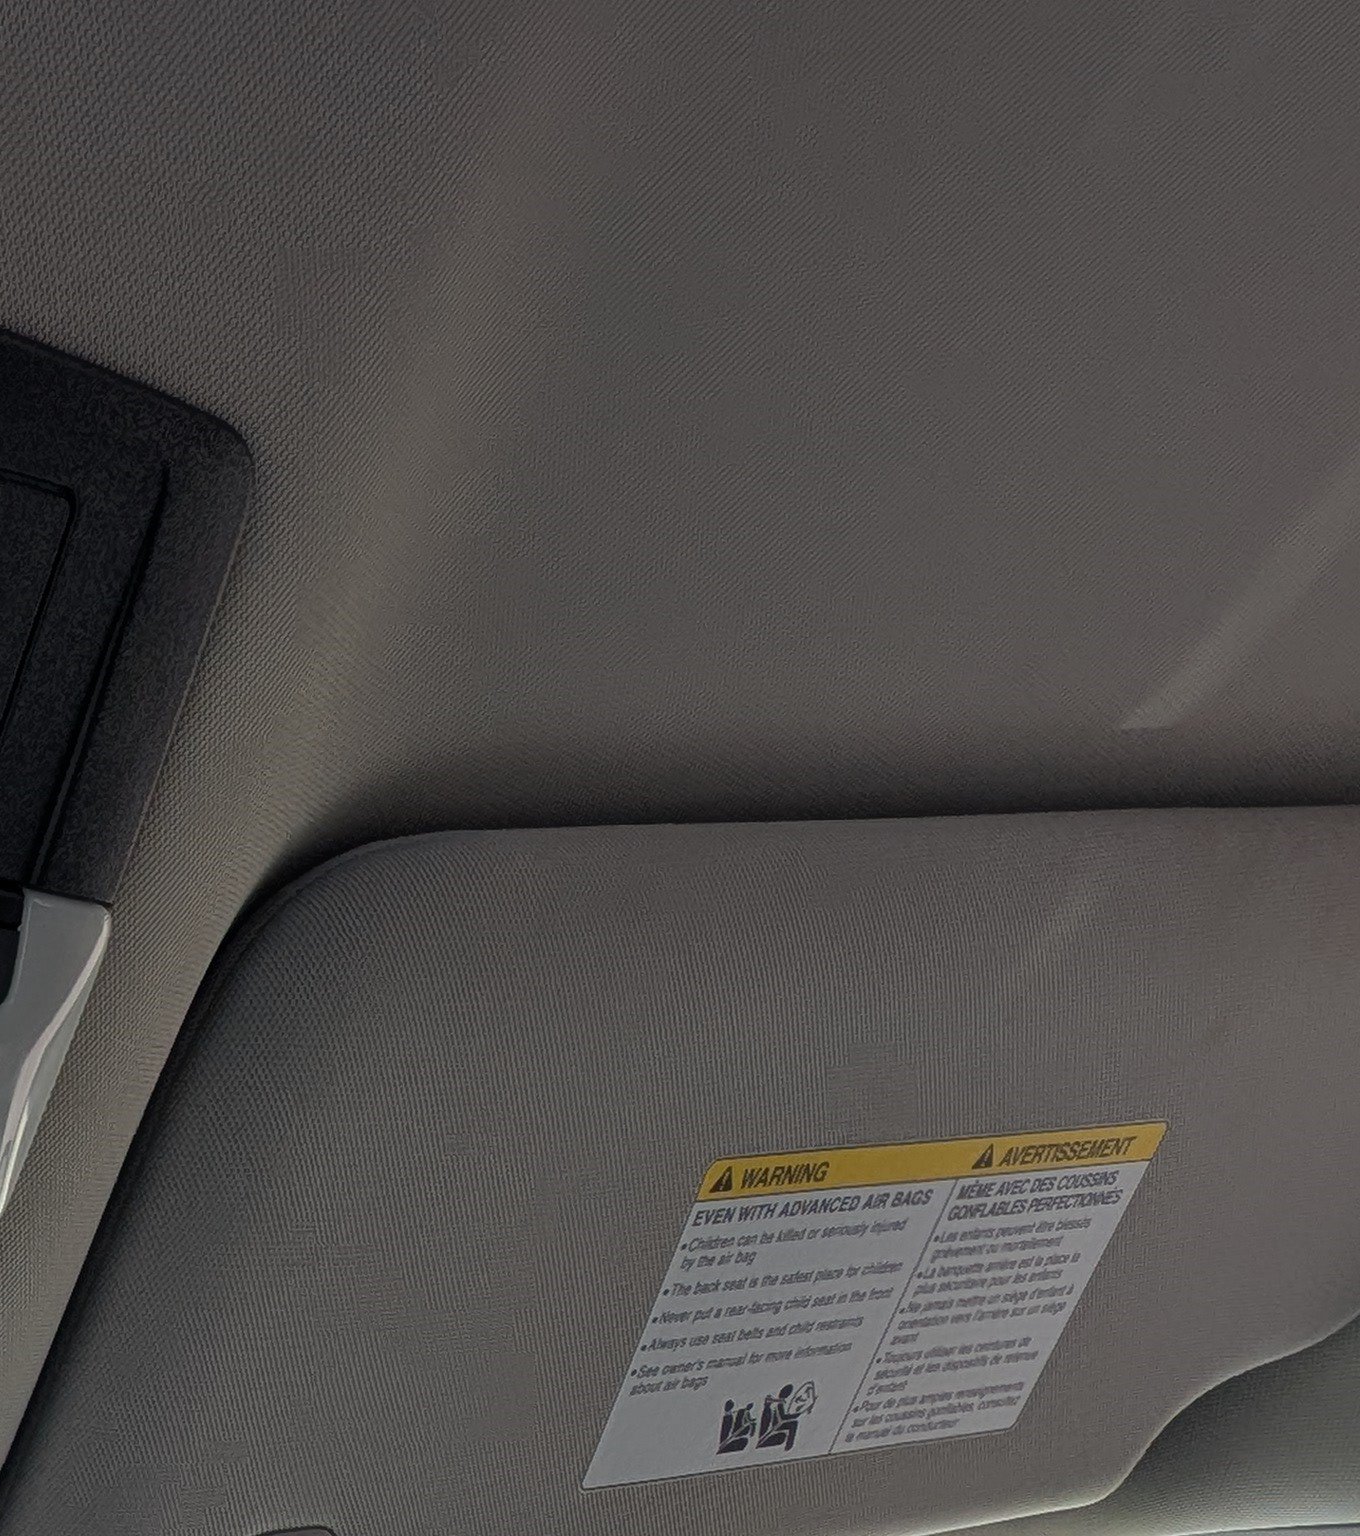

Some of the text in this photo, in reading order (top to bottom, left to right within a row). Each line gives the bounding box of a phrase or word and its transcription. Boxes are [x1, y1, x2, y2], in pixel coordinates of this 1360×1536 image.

[999, 1136, 1137, 1167] AVERTISSEMENT
[740, 1162, 830, 1189] WARNING
[996, 1180, 1027, 1196] AVEC
[1030, 1177, 1056, 1193] DES
[1056, 1170, 1119, 1190] COUSSINS
[691, 1189, 934, 1227] EVEN WITH ADVANCED AIR BAGS
[947, 1201, 1025, 1221] GONFLABLES
[688, 1235, 734, 1252] Children
[737, 1233, 757, 1246] can
[760, 1231, 773, 1244] be
[777, 1227, 805, 1243] killed
[807, 1228, 820, 1240] or
[681, 1250, 757, 1271] by the air bag
[670, 1283, 690, 1297] The
[693, 1280, 720, 1295] back
[722, 1277, 748, 1291] seat
[749, 1277, 758, 1288] is
[761, 1273, 779, 1287] the
[780, 1270, 814, 1286] safest
[813, 1267, 843, 1285] place
[660, 1309, 692, 1324] Never
[693, 1307, 714, 1323] put
[714, 1308, 722, 1319] a
[811, 1293, 835, 1307] seat
[647, 1335, 687, 1351] Always
[690, 1335, 709, 1347] use
[711, 1330, 736, 1345] seat
[737, 1327, 764, 1342] belts
[765, 1325, 785, 1338] and
[637, 1364, 659, 1378] See
[630, 1376, 709, 1396] about air bags
